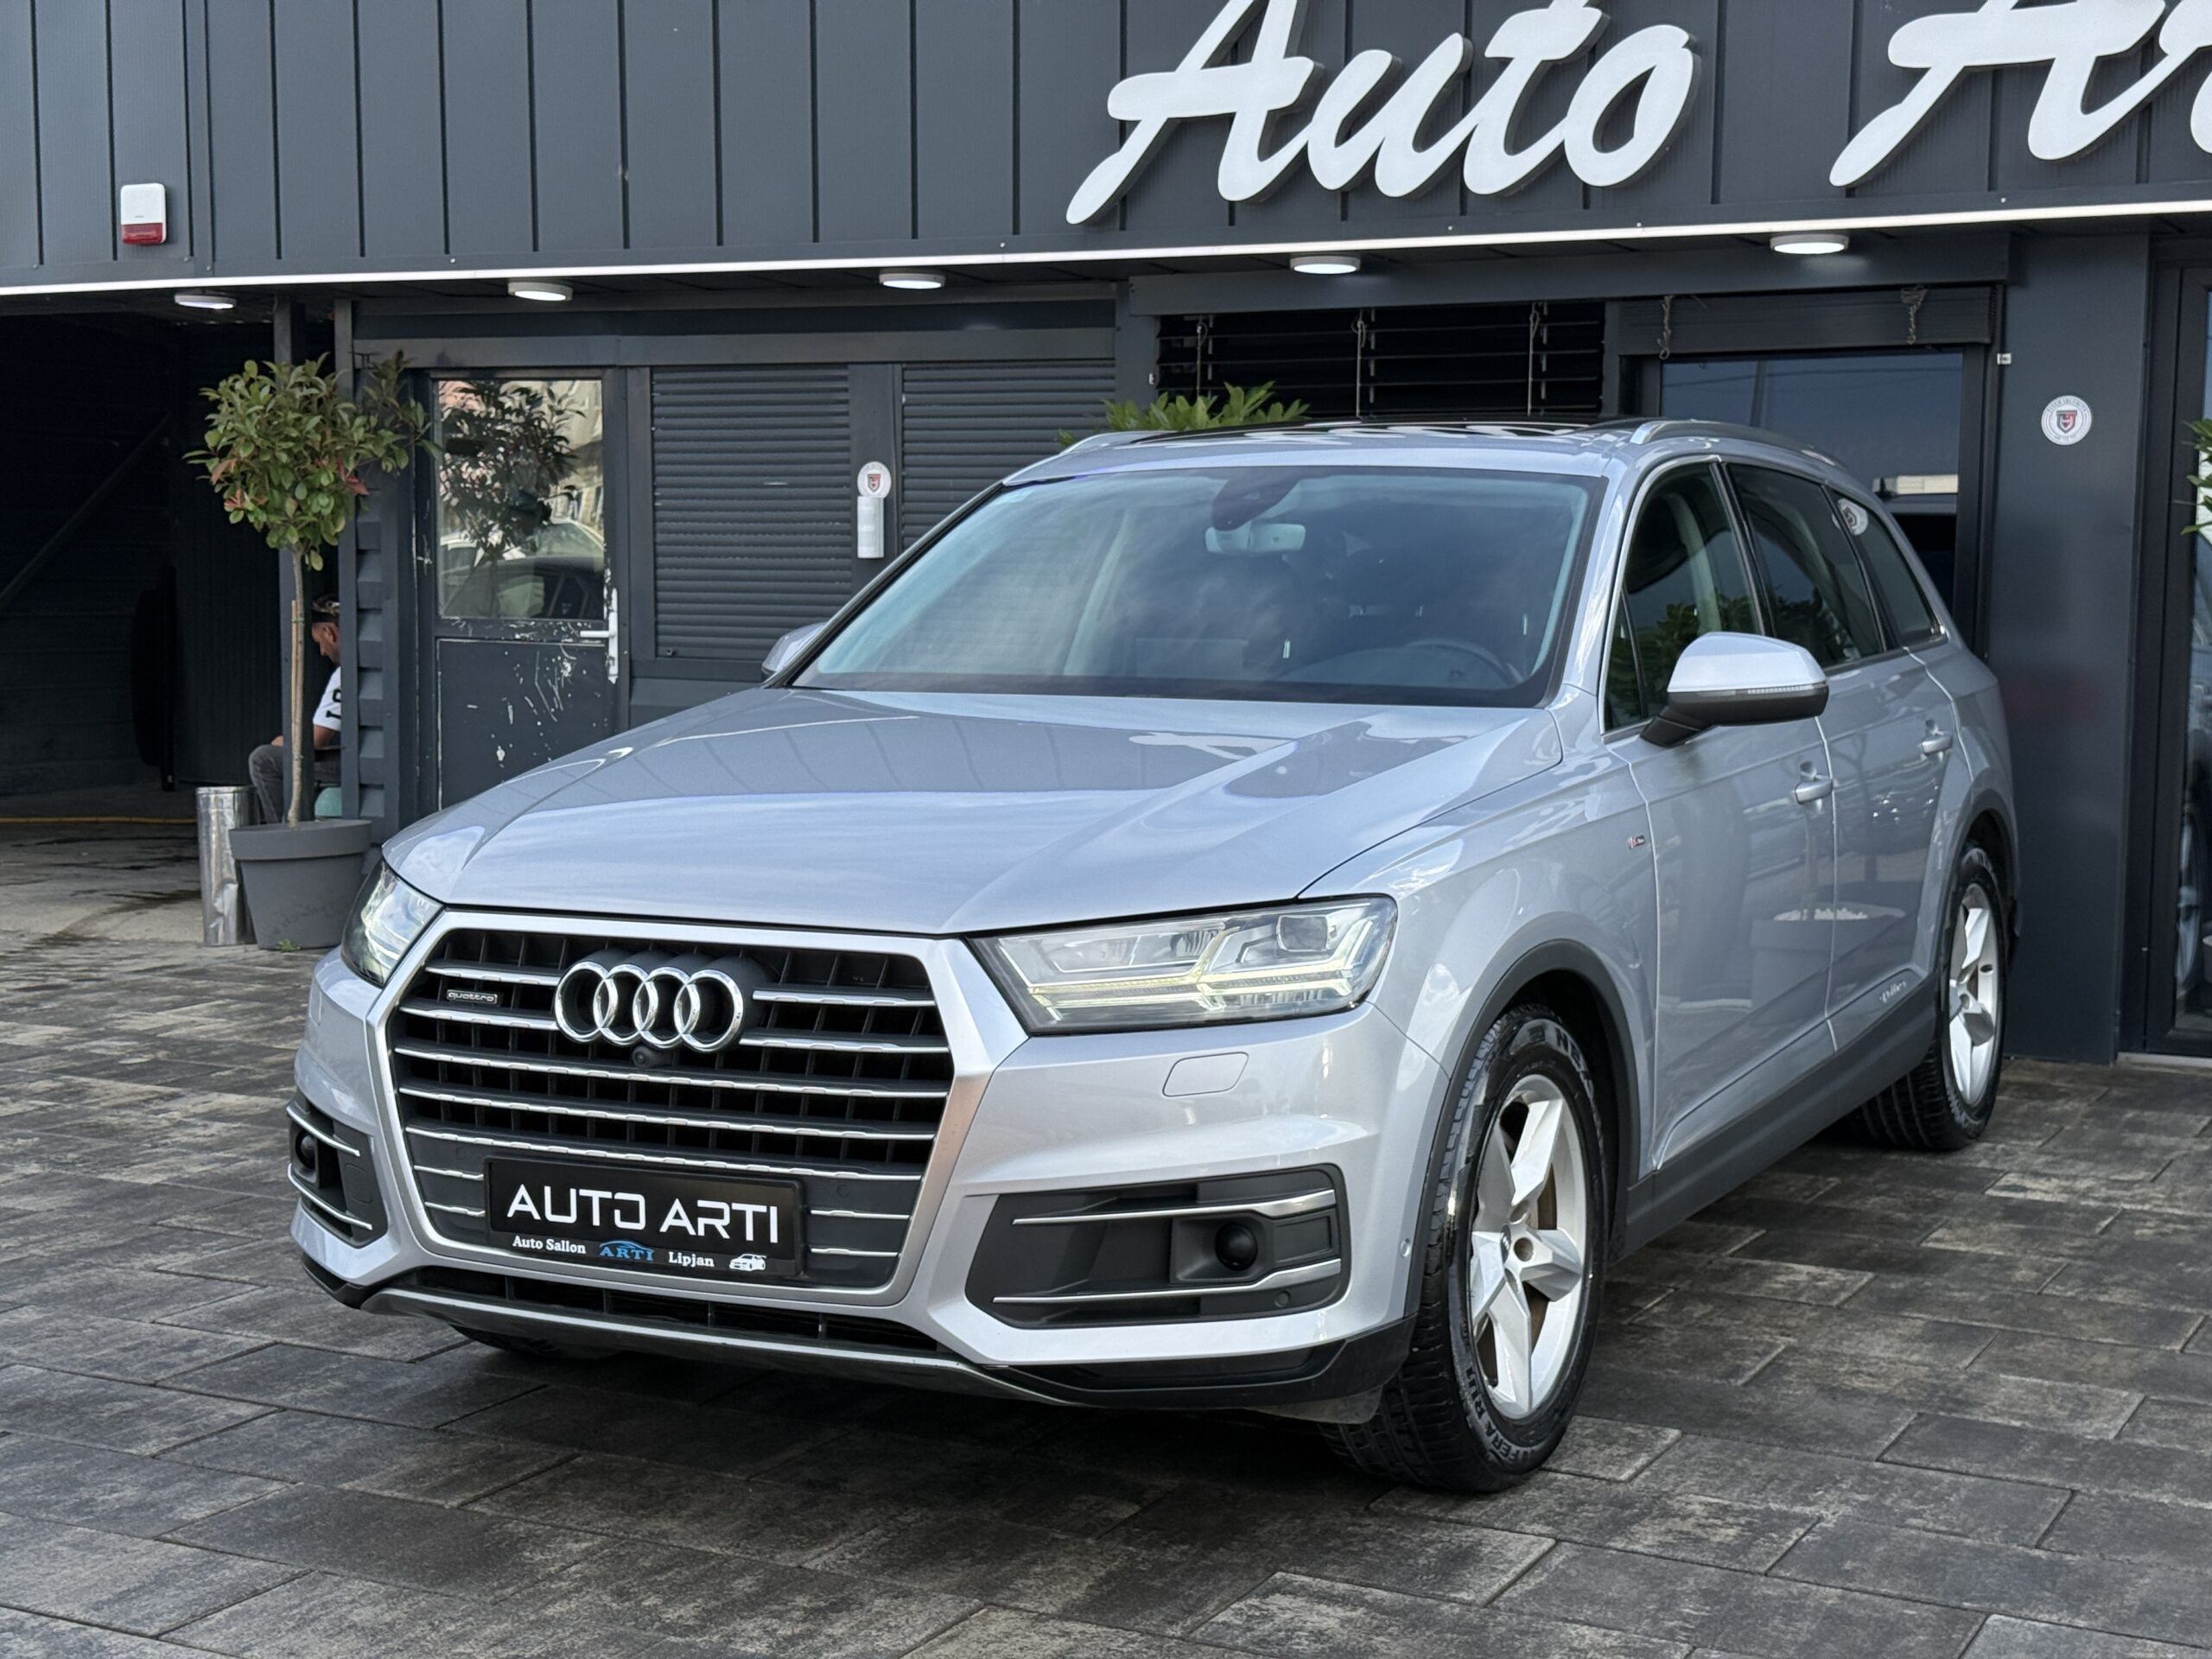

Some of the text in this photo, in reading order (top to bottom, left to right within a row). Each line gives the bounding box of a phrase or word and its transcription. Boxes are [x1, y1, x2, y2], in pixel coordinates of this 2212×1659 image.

[1066, 0, 1697, 224] Auto
[448, 992, 494, 1002] quattro
[506, 1184, 779, 1243] AUTO ARTI
[512, 1235, 715, 1268] Auto Sallon ARTI Lipjan
